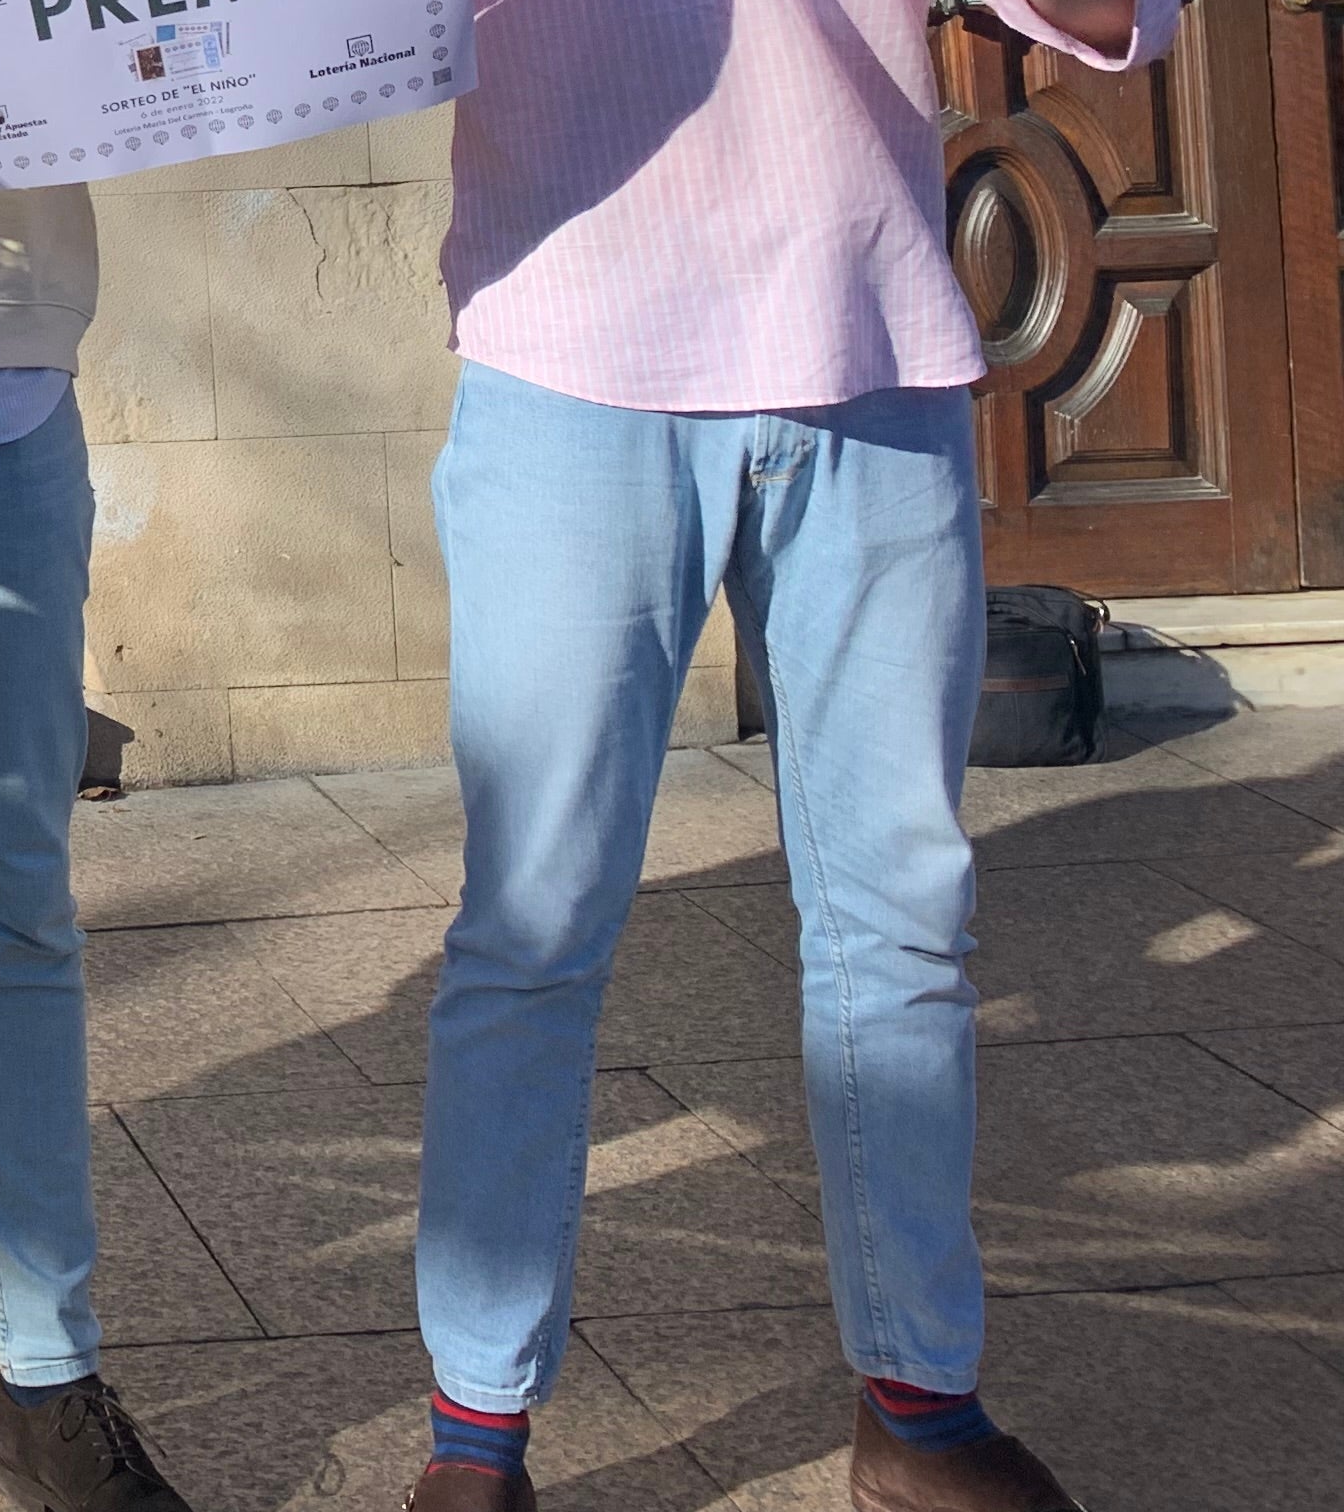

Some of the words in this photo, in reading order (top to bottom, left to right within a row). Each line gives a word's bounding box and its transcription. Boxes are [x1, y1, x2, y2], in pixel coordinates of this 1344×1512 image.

[359, 46, 416, 68] Nacional
[101, 93, 158, 115] SORTEO
[161, 88, 180, 102] DE
[150, 108, 163, 117] de
[197, 95, 225, 108] 2022
[4, 119, 48, 132] Apuestas
